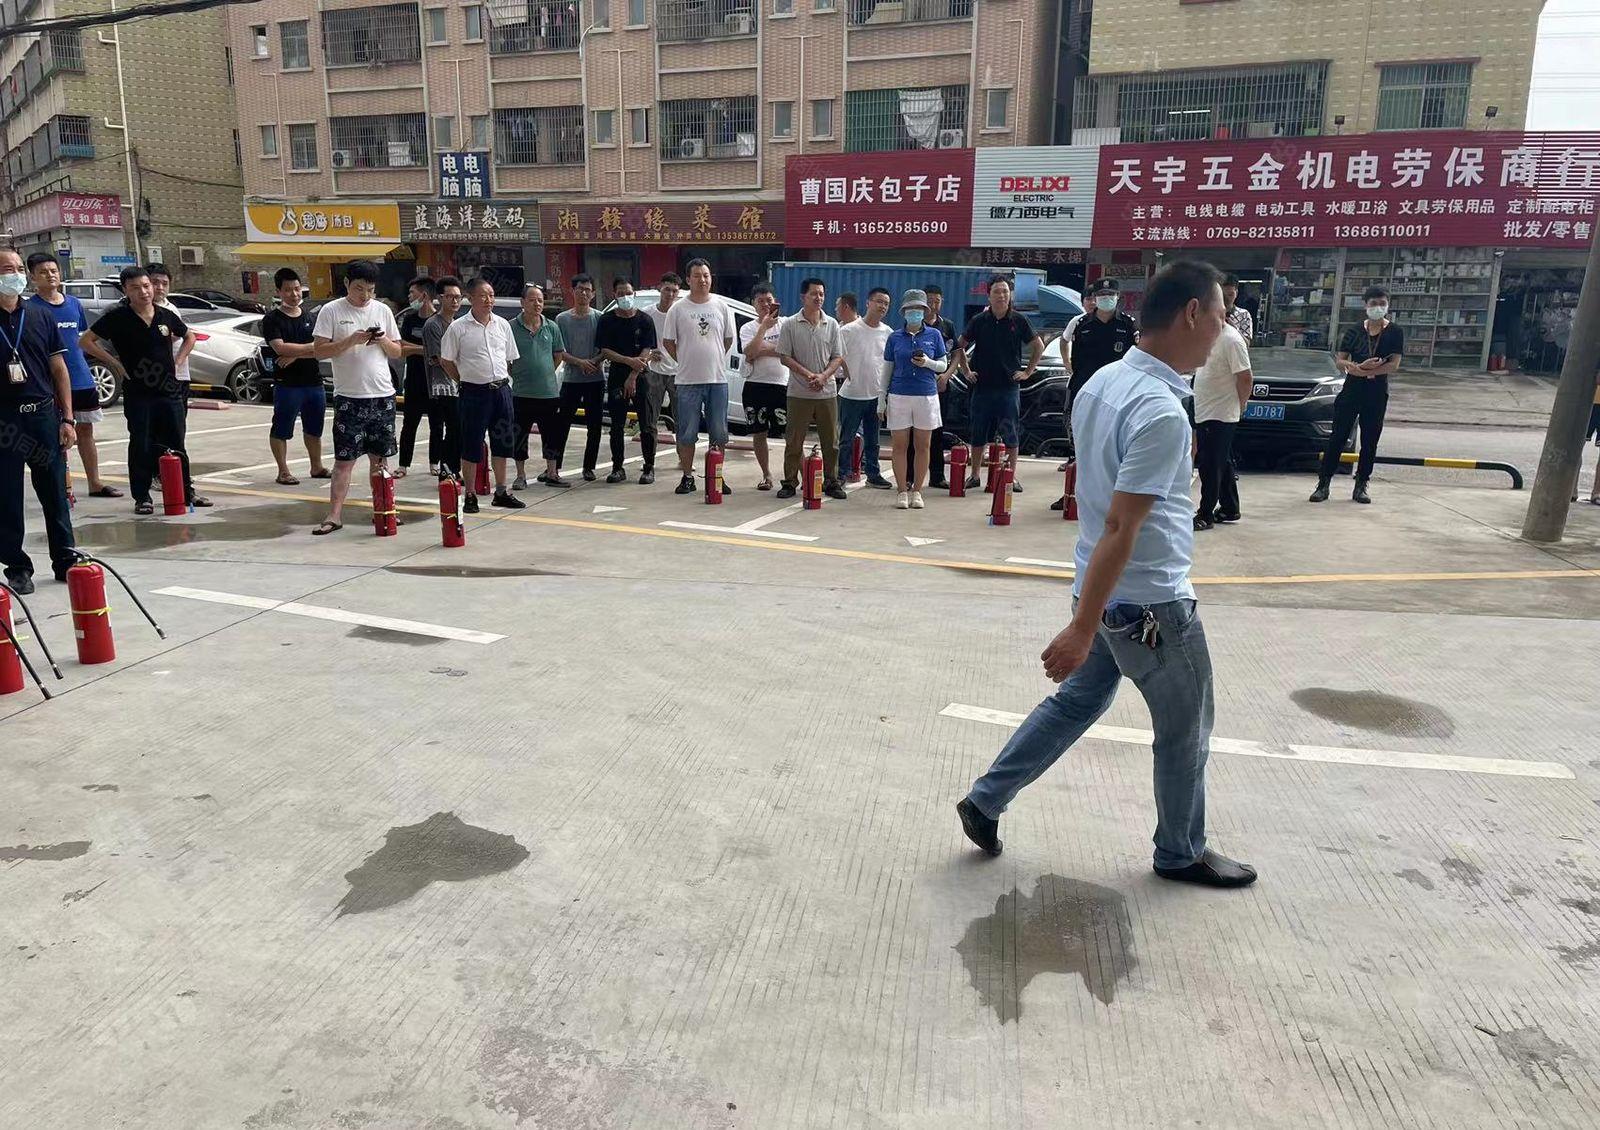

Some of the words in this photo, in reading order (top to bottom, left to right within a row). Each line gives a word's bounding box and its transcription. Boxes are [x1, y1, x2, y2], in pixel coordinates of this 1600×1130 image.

[799, 174, 962, 205] 曹国庆包子店
[1000, 176, 1070, 192] DELIXI
[1013, 194, 1055, 202] ELECTRIC
[989, 206, 1075, 219] 德力西电气
[1184, 204, 1245, 218] 电线电缆
[1255, 202, 1315, 217] 电动工具
[1325, 200, 1388, 216] 水暖卫浴
[1398, 199, 1495, 215] 文具劳保用品
[1506, 199, 1595, 215] 定制配电柜
[1334, 224, 1431, 238] 13686110011
[1503, 220, 1591, 239] 批发/零售
